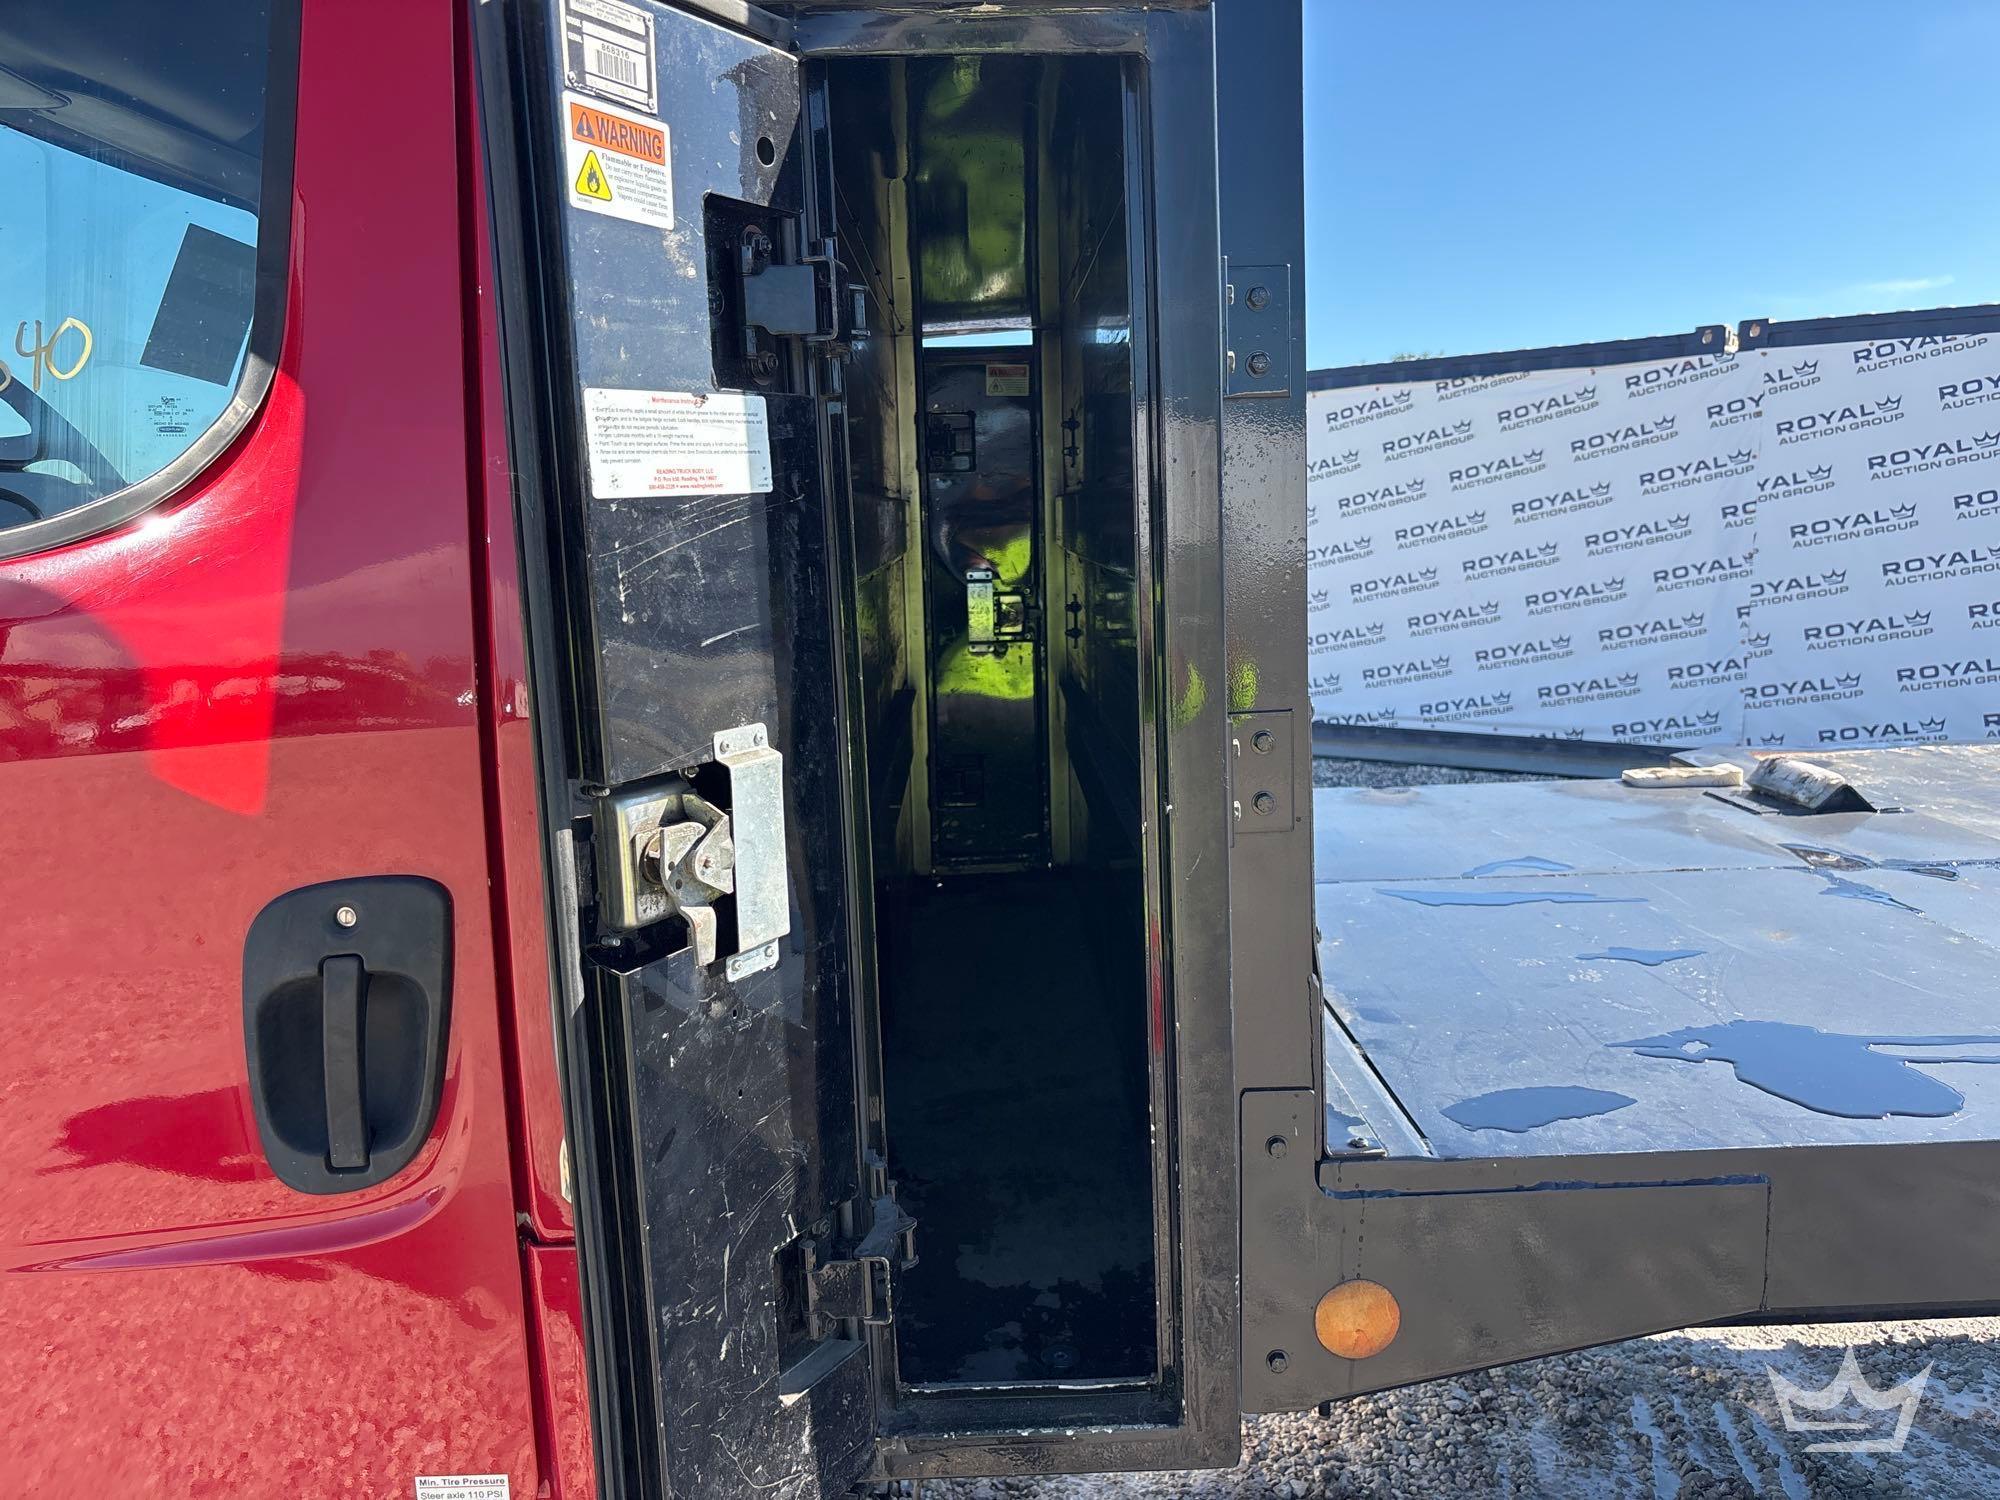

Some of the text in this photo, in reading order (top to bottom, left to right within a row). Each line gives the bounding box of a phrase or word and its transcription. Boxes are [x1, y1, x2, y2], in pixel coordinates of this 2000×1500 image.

[596, 116, 662, 159] WARNING
[1856, 337, 1988, 374] AUCTION GROUP
[1625, 357, 1713, 389] ROYAL
[1628, 378, 1687, 399] AUCTION
[1690, 363, 1740, 382] GROUP
[1438, 371, 1530, 402] AUCTION GROUP
[1768, 376, 1821, 396] GROUP
[1326, 397, 1393, 424] ROYAL
[1498, 394, 1576, 424] ROYAL
[1500, 401, 1599, 432] AUCTION GROUP
[1707, 390, 1766, 419] ROY
[1328, 403, 1414, 432] AUCTION GROUP
[1776, 404, 1875, 436] ROYAL
[1779, 412, 1904, 446] AUCTION GROUP
[1382, 426, 1453, 453] ROYAL
[1384, 433, 1474, 462] AUCTION GROUP
[1571, 424, 1653, 453] ROYAL
[1573, 430, 1679, 463] AUCTION GROUP
[1868, 440, 1973, 470] ROYAL
[1326, 462, 1361, 478] GROUP
[1449, 456, 1524, 484] ROYAL
[1452, 463, 1546, 492] AUCTION GROUP
[1640, 456, 1728, 486] ROYAL
[1642, 465, 1755, 496] AUCTION GROUP
[1871, 460, 1942, 481] AUCTION
[1338, 485, 1407, 510] ROYAL
[1782, 481, 1835, 498] GROUP
[1340, 492, 1427, 518] AUCTION GROUP
[1512, 488, 1590, 516] ROYAL
[1514, 496, 1614, 525] AUCTION GROUP
[1395, 517, 1467, 542] ROYAL
[1585, 521, 1668, 548] ROYAL
[1790, 510, 1890, 539] ROYAL
[1792, 520, 1919, 549] AUCTION GROUP
[1397, 525, 1488, 550] AUCTION GROUP
[1588, 528, 1692, 557] AUCTION GROUP
[1338, 550, 1373, 563] GROUP
[1462, 548, 1538, 573] ROYAL
[1882, 549, 1987, 576] ROYAL
[1464, 556, 1560, 582] AUCTION GROUP
[1654, 557, 1742, 583] ROYAL
[1885, 569, 1956, 587] AUCTION
[1351, 573, 1419, 596] ROYAL
[1353, 581, 1440, 604] AUCTION GROUP
[1525, 583, 1604, 607] ROYAL
[1656, 575, 1716, 593] AUCTION
[1796, 586, 1849, 600] GROUP
[1528, 592, 1628, 616] AUCTION GROUP
[1408, 607, 1480, 629] ROYAL
[1410, 615, 1501, 638] AUCTION GROUP
[1598, 618, 1681, 642] ROYAL
[1804, 617, 1904, 641] ROYAL
[1350, 636, 1386, 648] GROUP
[1475, 640, 1551, 662] ROYAL
[1601, 628, 1707, 651] AUCTION GROUP
[1807, 628, 1933, 651] AUCTION GROUP
[1363, 661, 1432, 681] ROYAL
[1478, 650, 1574, 671] AUCTION GROUP
[1897, 659, 2000, 682] ROYAL
[1365, 670, 1452, 689] AUCTION GROUP
[1538, 678, 1617, 699] ROYAL
[1670, 674, 1731, 689] AUCTION
[1743, 678, 1835, 702] ROYAL
[1900, 678, 1971, 692] AUCTION
[1420, 696, 1492, 716] ROYAL
[1540, 688, 1641, 708] AUCTION GROUP
[1744, 690, 1864, 710] AUCTION GROUP
[1474, 705, 1514, 718] GROUP
[1612, 716, 1696, 736] ROYAL
[1674, 726, 1722, 738] GROUP
[1818, 722, 1918, 742] ROYAL
[420, 1492, 444, 1500] Steer
